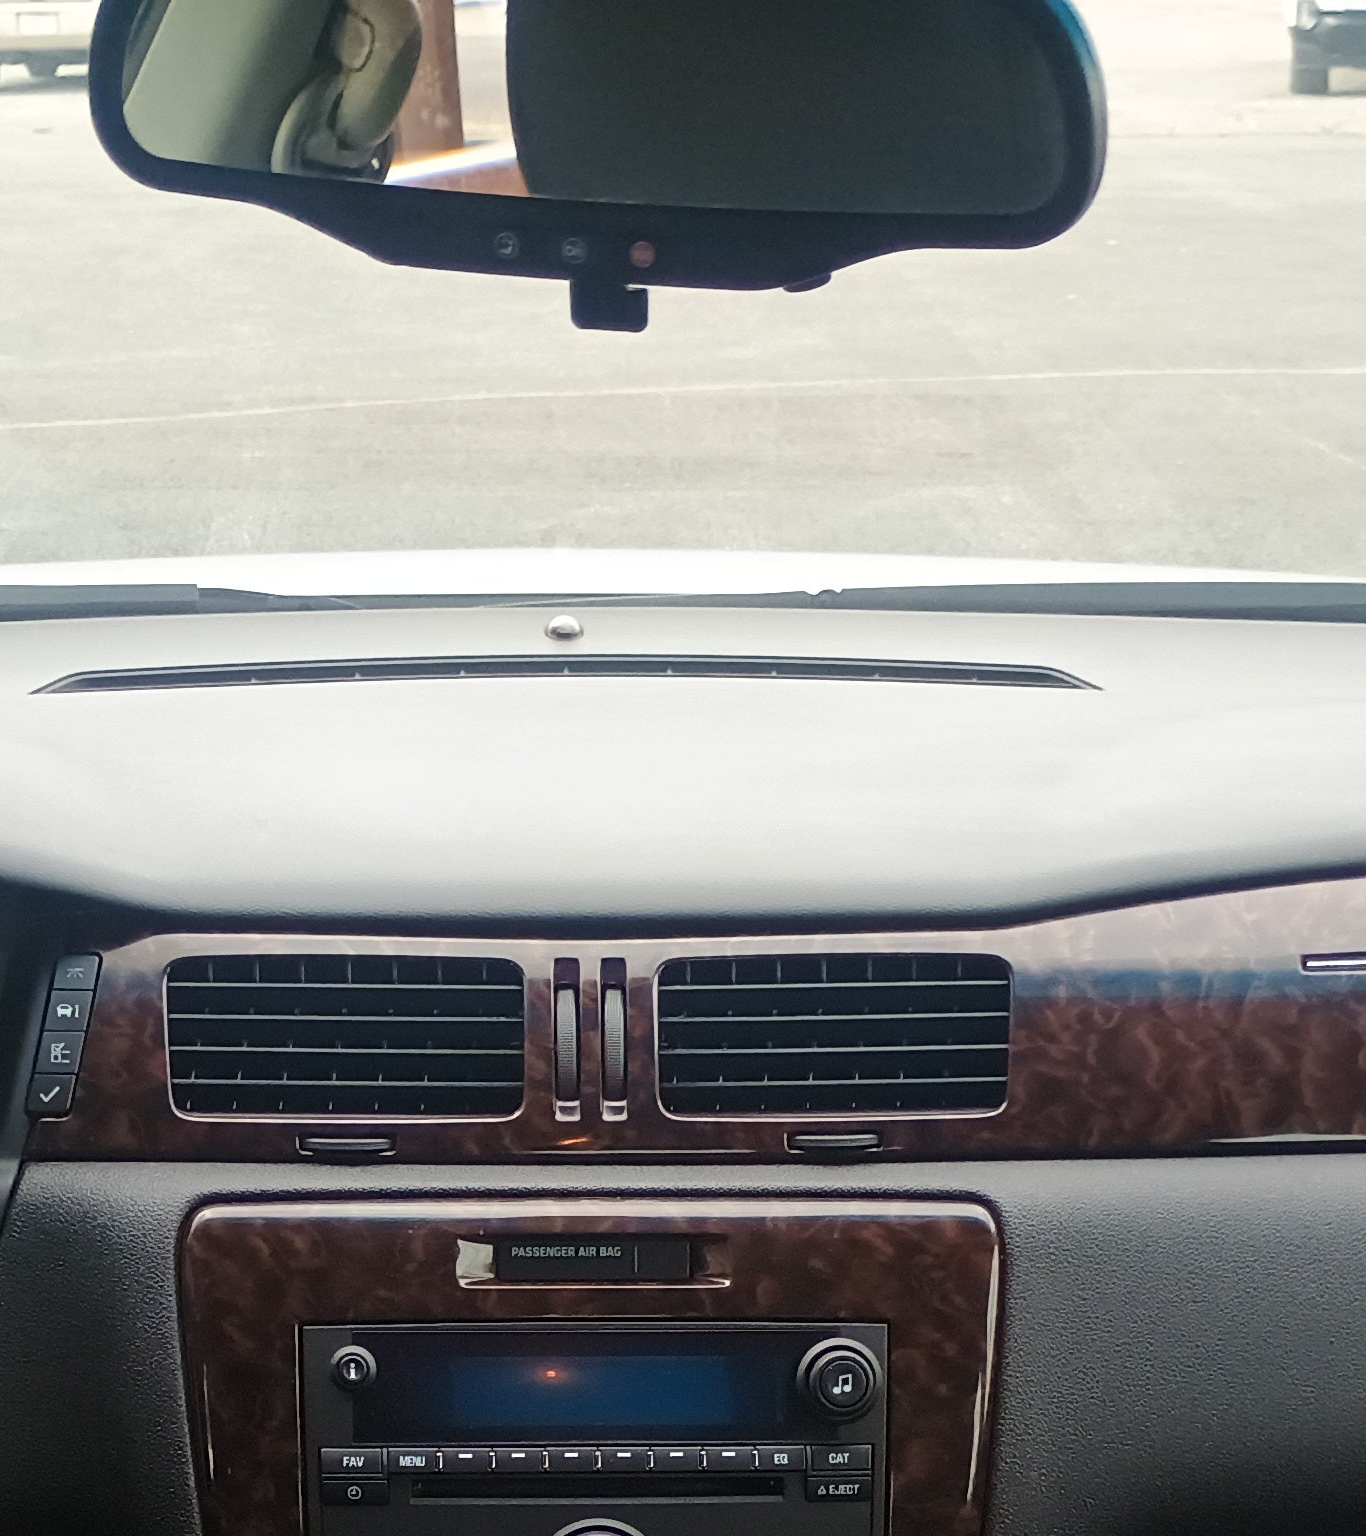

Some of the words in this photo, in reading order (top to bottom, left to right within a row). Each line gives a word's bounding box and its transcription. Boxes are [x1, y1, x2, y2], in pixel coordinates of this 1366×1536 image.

[511, 1246, 576, 1257] PASSENGER
[578, 1247, 597, 1257] AIR
[599, 1247, 622, 1257] BAG
[342, 1456, 365, 1467] FAV
[399, 1455, 426, 1467] MENU
[774, 1453, 789, 1465] EQ
[828, 1453, 850, 1464] CAT
[828, 1484, 860, 1495] EJECT
